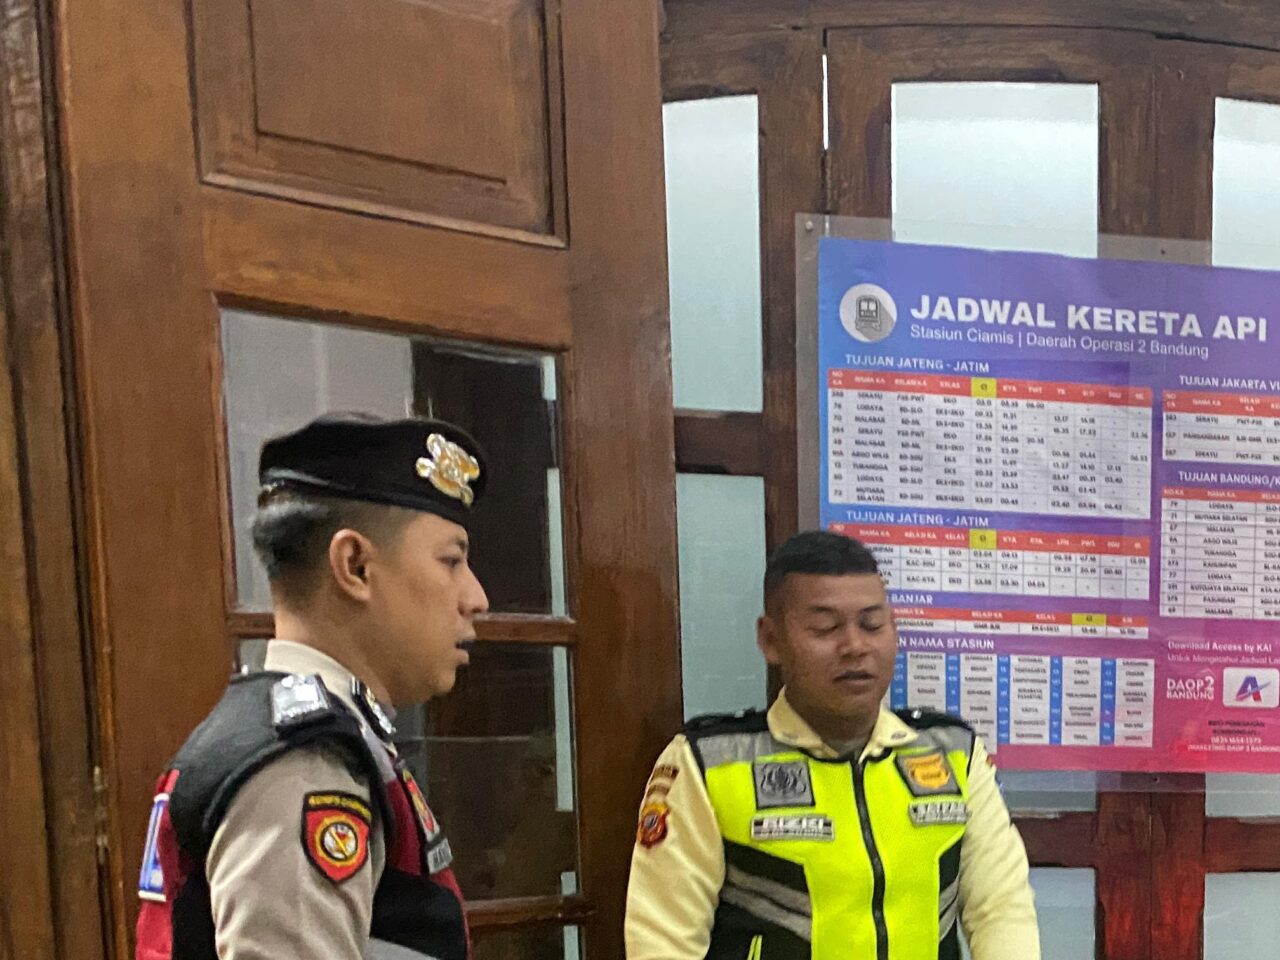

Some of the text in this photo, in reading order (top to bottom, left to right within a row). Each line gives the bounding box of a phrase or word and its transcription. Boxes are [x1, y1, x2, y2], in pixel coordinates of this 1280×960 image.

[910, 295, 1267, 342] JADWAL KERETA API
[910, 325, 963, 341] Stasiun
[967, 328, 1014, 345] Ciamis
[1026, 332, 1077, 349] Daerah
[1080, 336, 1134, 354] Operasi
[1138, 341, 1147, 353] 2
[1150, 342, 1209, 359] Bandung
[845, 354, 894, 367] TUJUAN
[897, 357, 943, 370] JATENG
[953, 361, 990, 373] JATIM
[1179, 375, 1219, 387] TUJUAN
[1221, 377, 1267, 391] JAKARTA
[1178, 472, 1218, 483] TUJUAN
[846, 511, 894, 523] TUJUAN
[897, 514, 944, 526] JATENG
[953, 516, 989, 527] JATIM
[892, 593, 933, 606] BANJAR
[909, 636, 995, 650] NAMA STASIUN
[1168, 641, 1272, 653] Download Access by KAI
[1166, 675, 1215, 691] DAOP 2
[1166, 689, 1215, 701] BANDUNG
